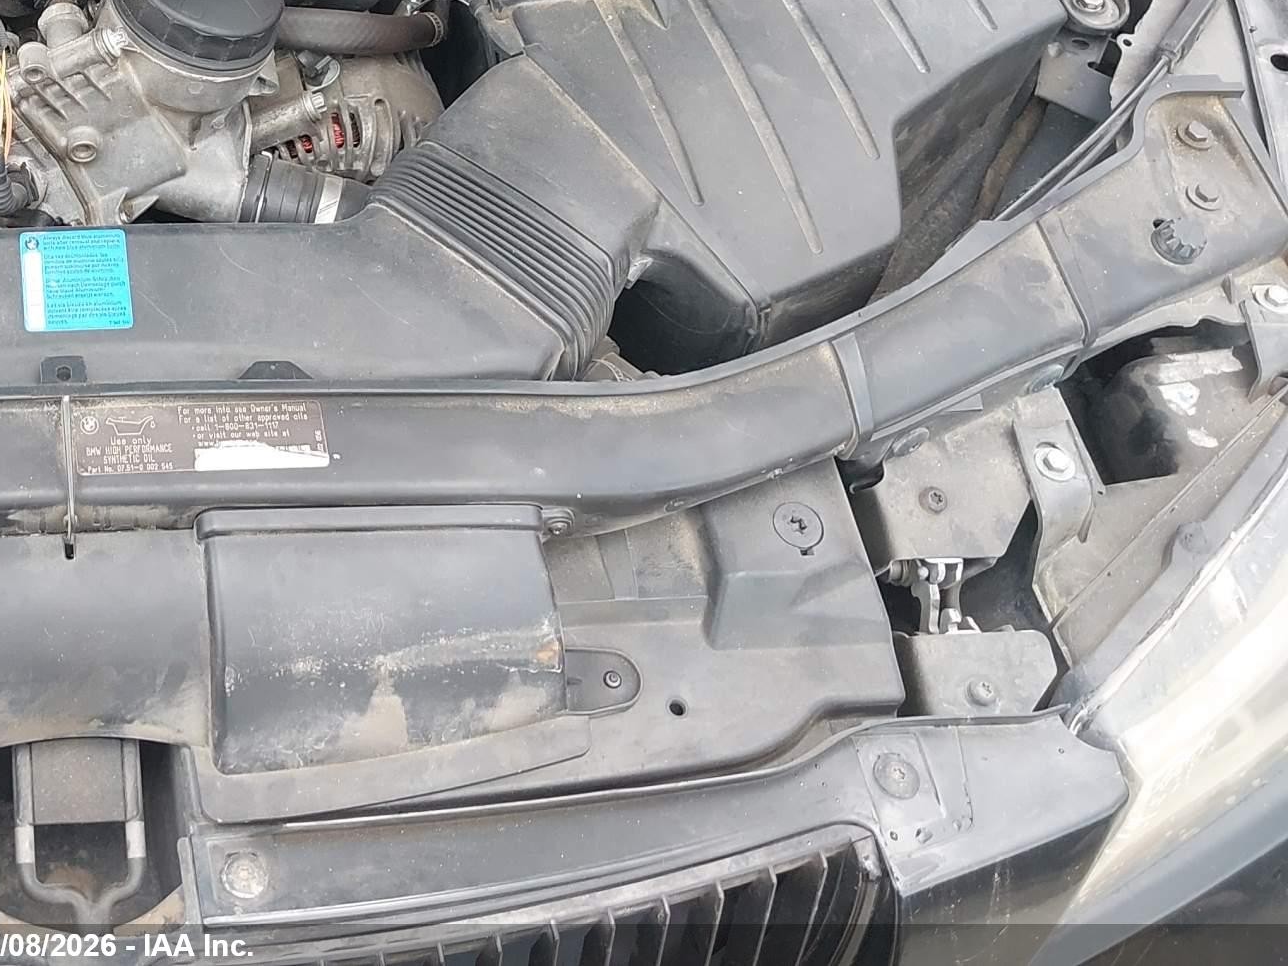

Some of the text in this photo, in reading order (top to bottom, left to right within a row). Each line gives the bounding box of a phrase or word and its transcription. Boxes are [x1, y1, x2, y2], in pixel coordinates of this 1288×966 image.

[178, 406, 190, 415] For
[194, 406, 211, 414] more
[235, 405, 247, 413] see
[251, 403, 278, 413] Owner's
[282, 402, 307, 412] Manual
[204, 414, 217, 423] list
[222, 414, 229, 422] of
[234, 412, 252, 422] other
[257, 412, 289, 422] approved
[294, 412, 308, 420] oils
[215, 421, 279, 430] 1-800-831-1117
[209, 430, 225, 439] visit
[231, 430, 242, 438] our
[246, 429, 259, 438] web
[264, 429, 278, 437] site
[110, 435, 152, 446] Use only
[86, 443, 172, 456] BMW HIGH PERFORMANCE
[103, 454, 155, 464] SYNTHETIC OIL
[88, 465, 101, 474] Part
[104, 464, 114, 472] No.
